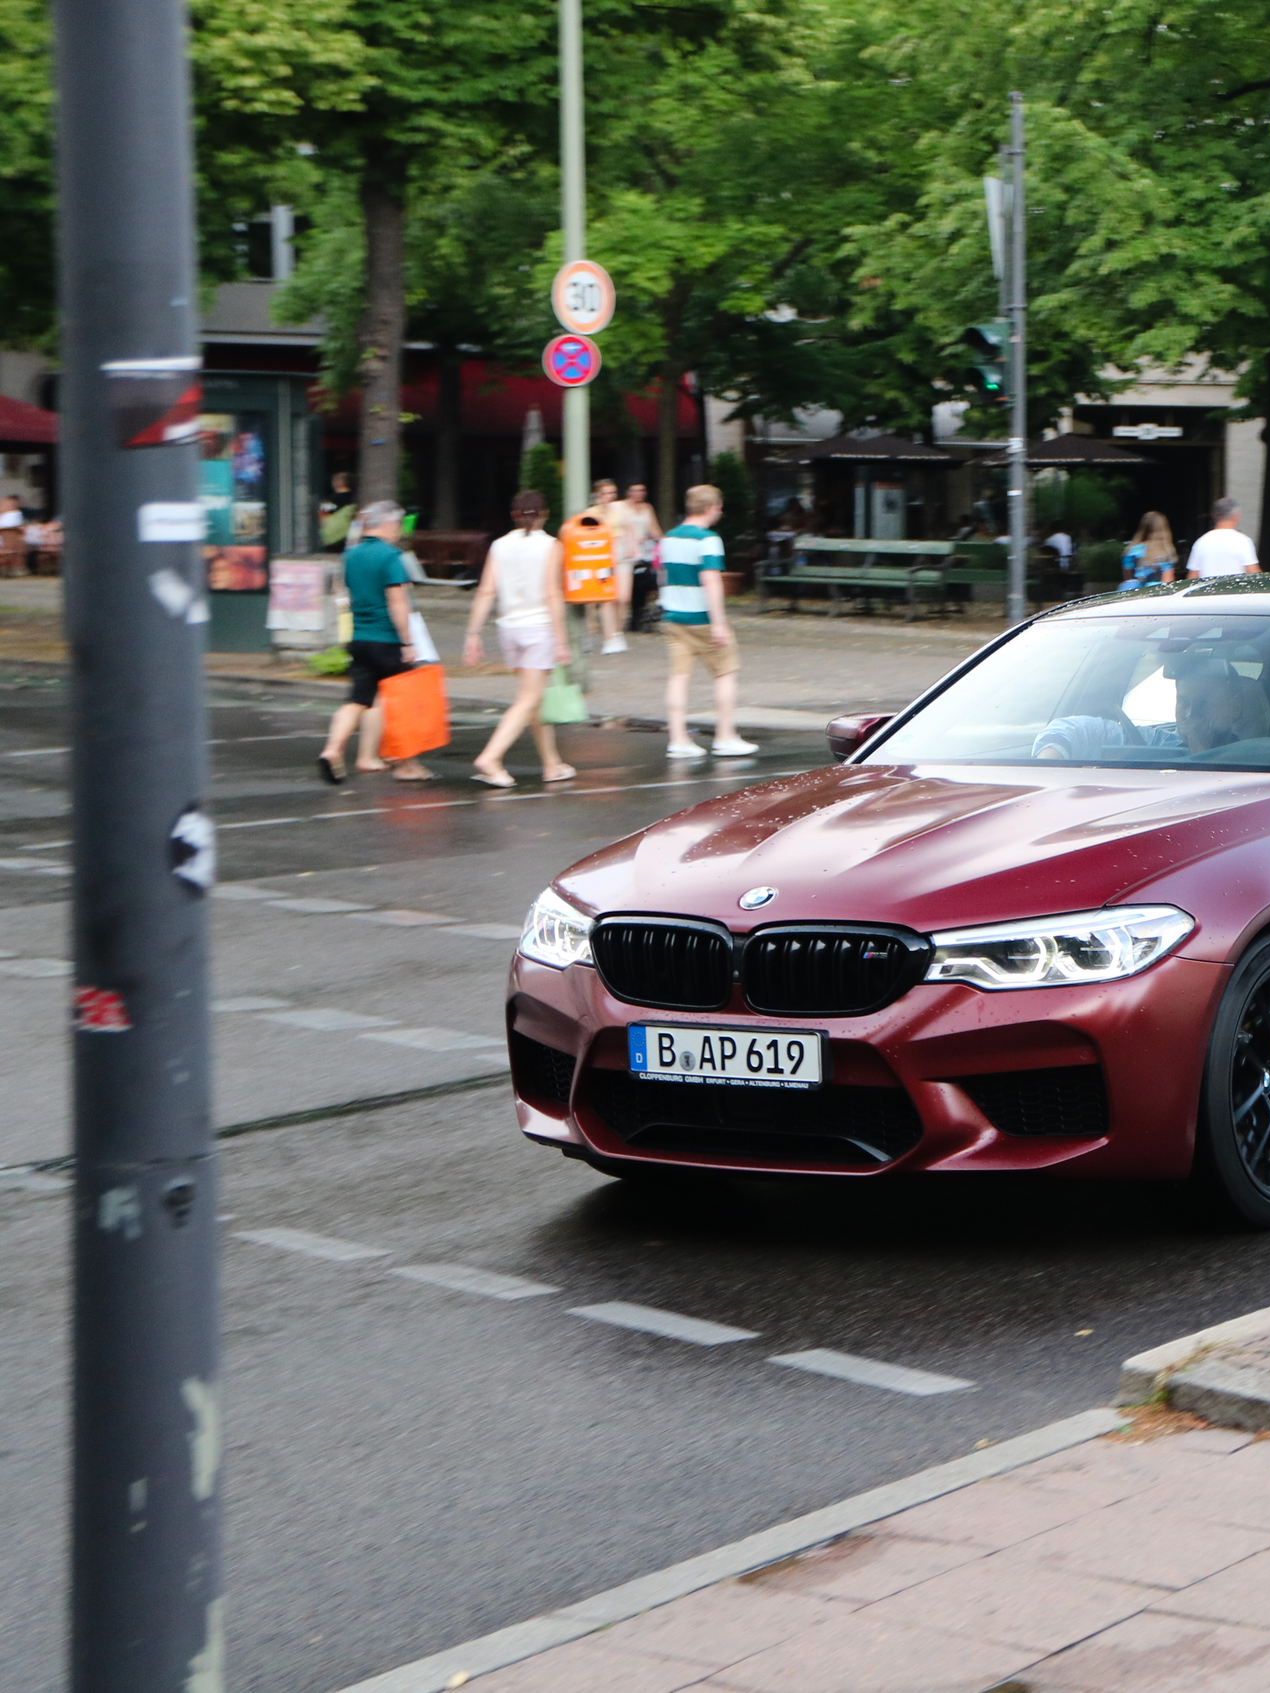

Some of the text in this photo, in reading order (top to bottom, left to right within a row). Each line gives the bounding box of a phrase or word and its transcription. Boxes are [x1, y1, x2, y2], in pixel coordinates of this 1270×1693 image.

[566, 281, 600, 312] 30
[636, 1053, 643, 1063] D
[658, 1032, 805, 1075] B AP 619
